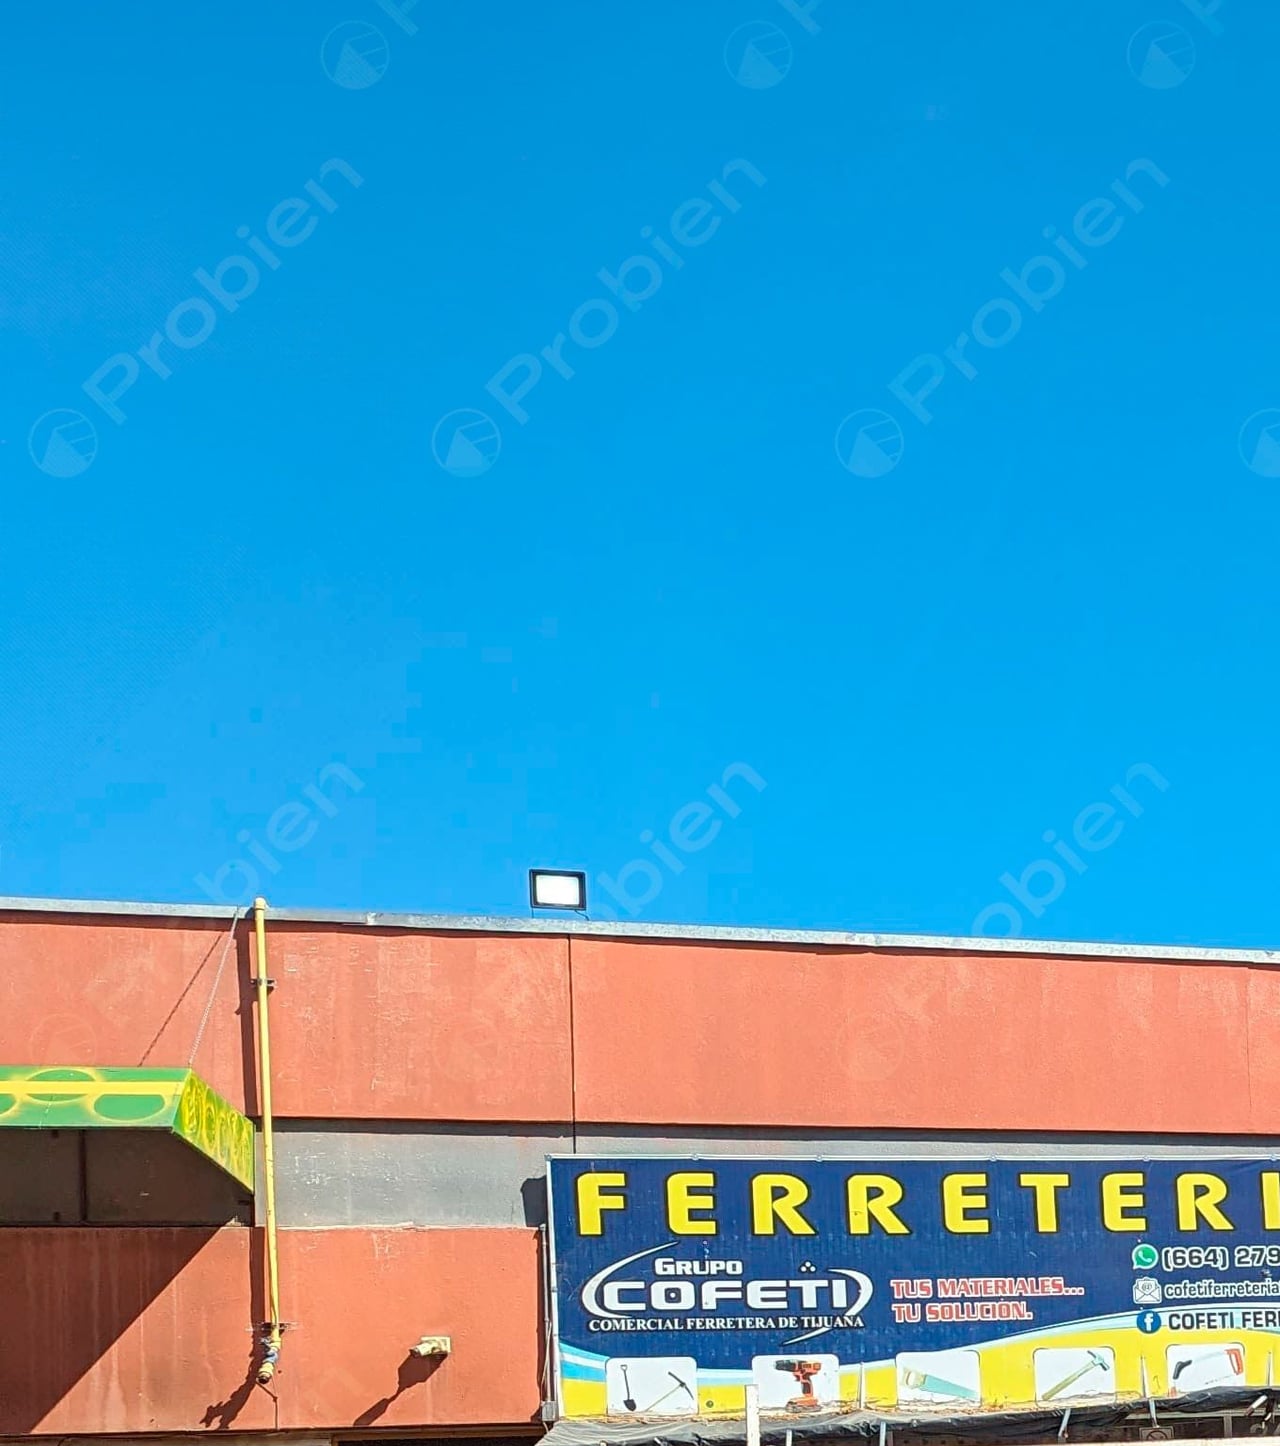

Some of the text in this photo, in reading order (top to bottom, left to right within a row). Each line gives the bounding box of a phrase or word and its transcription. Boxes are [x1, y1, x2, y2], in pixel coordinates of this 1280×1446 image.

[655, 1257, 743, 1276] GRUPO
[1162, 1246, 1229, 1271] (664)
[602, 1279, 848, 1311] COFETI
[890, 1279, 932, 1299] TUS
[892, 1303, 921, 1322] TU
[1168, 1312, 1235, 1330] COFETI
[588, 1315, 865, 1331] COMERCIAL FERRETERA DE TIJUANA
